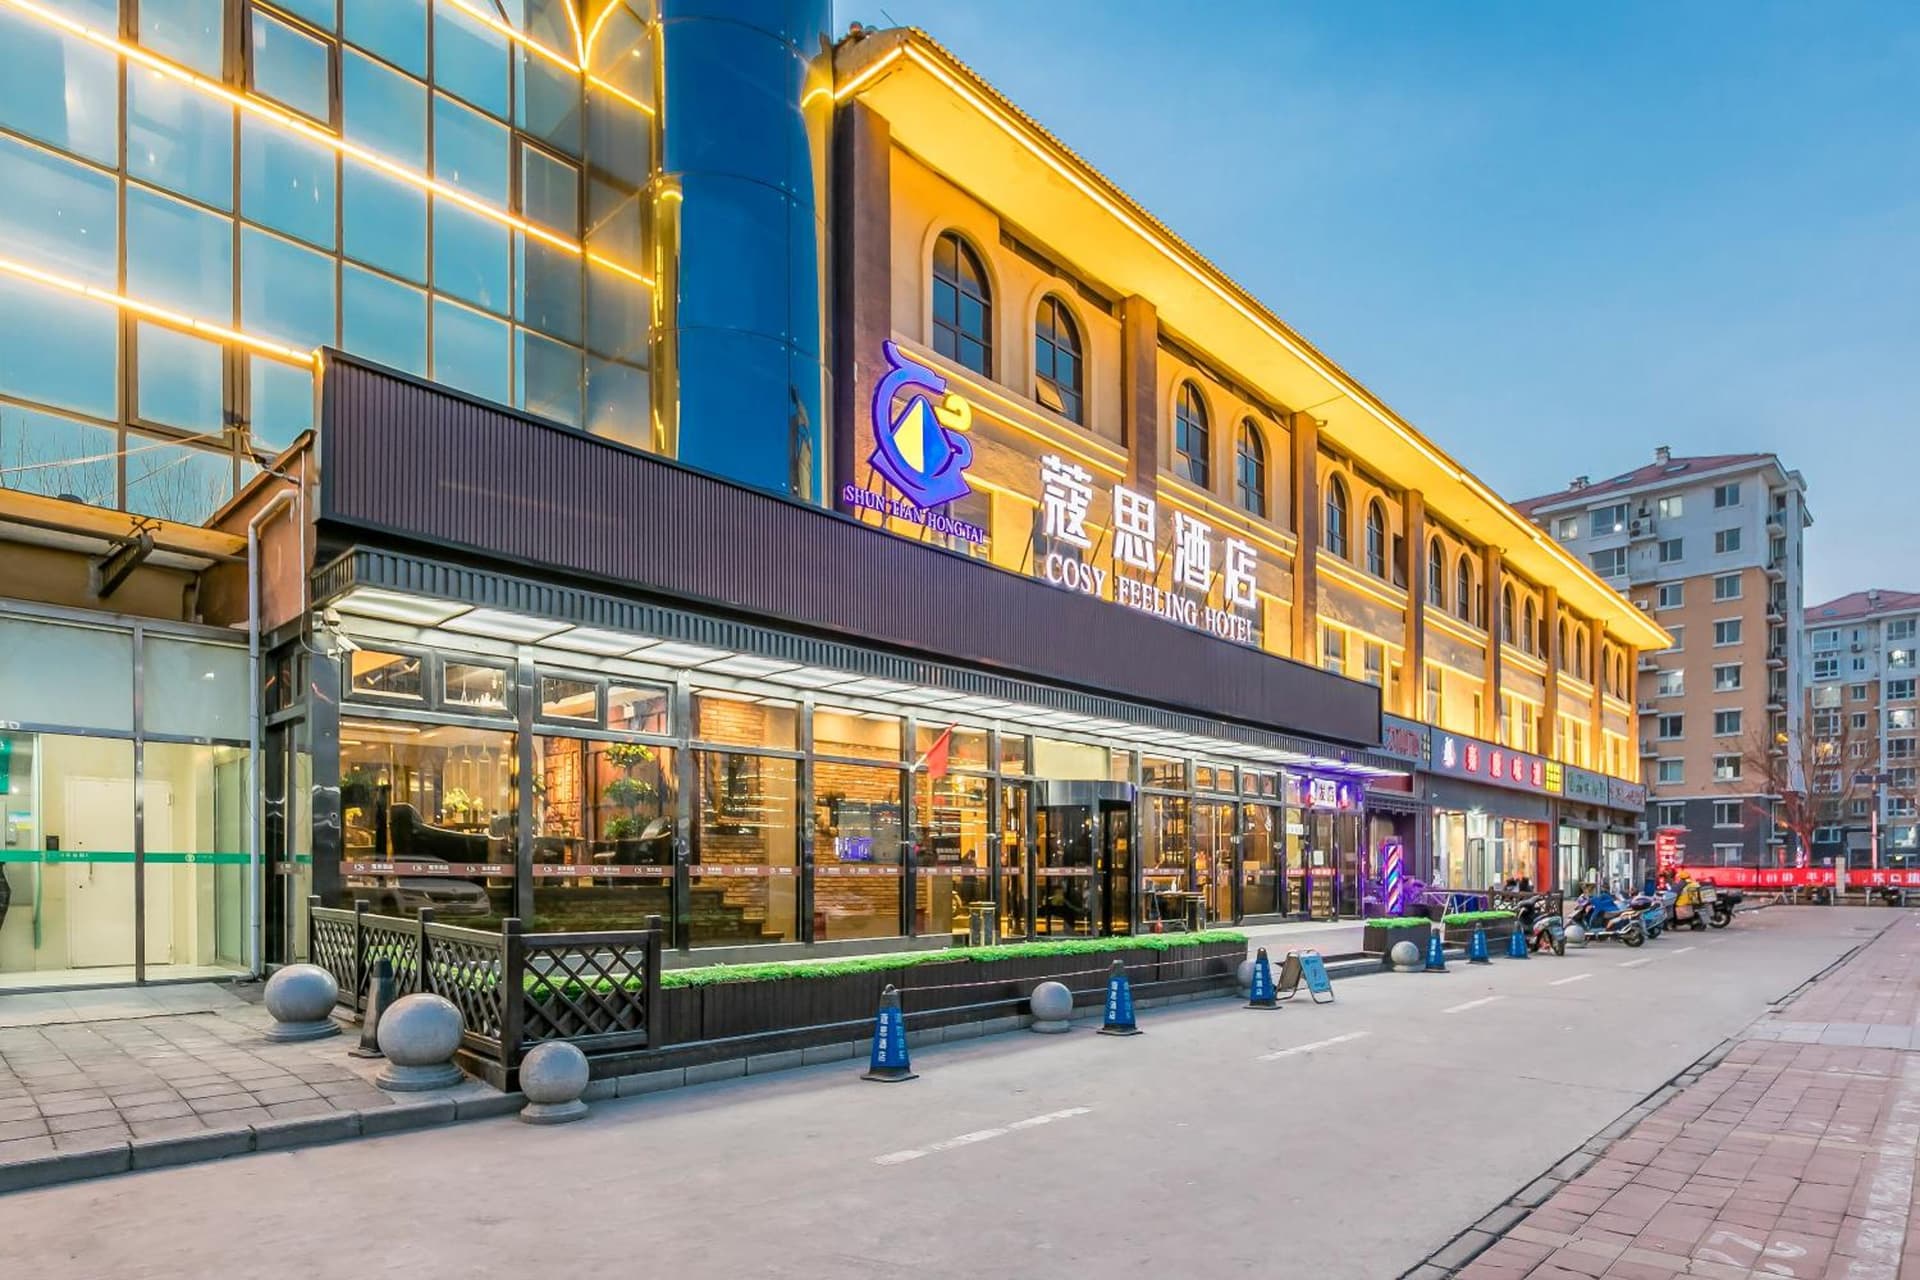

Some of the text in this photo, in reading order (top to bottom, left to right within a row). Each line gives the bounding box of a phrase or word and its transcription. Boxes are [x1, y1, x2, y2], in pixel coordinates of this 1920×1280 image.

[844, 484, 886, 512] SHUN
[890, 499, 924, 524] TIAN
[1041, 454, 1258, 609] 蔻思酒店
[1046, 553, 1255, 643] COSY FEELING HOTEL
